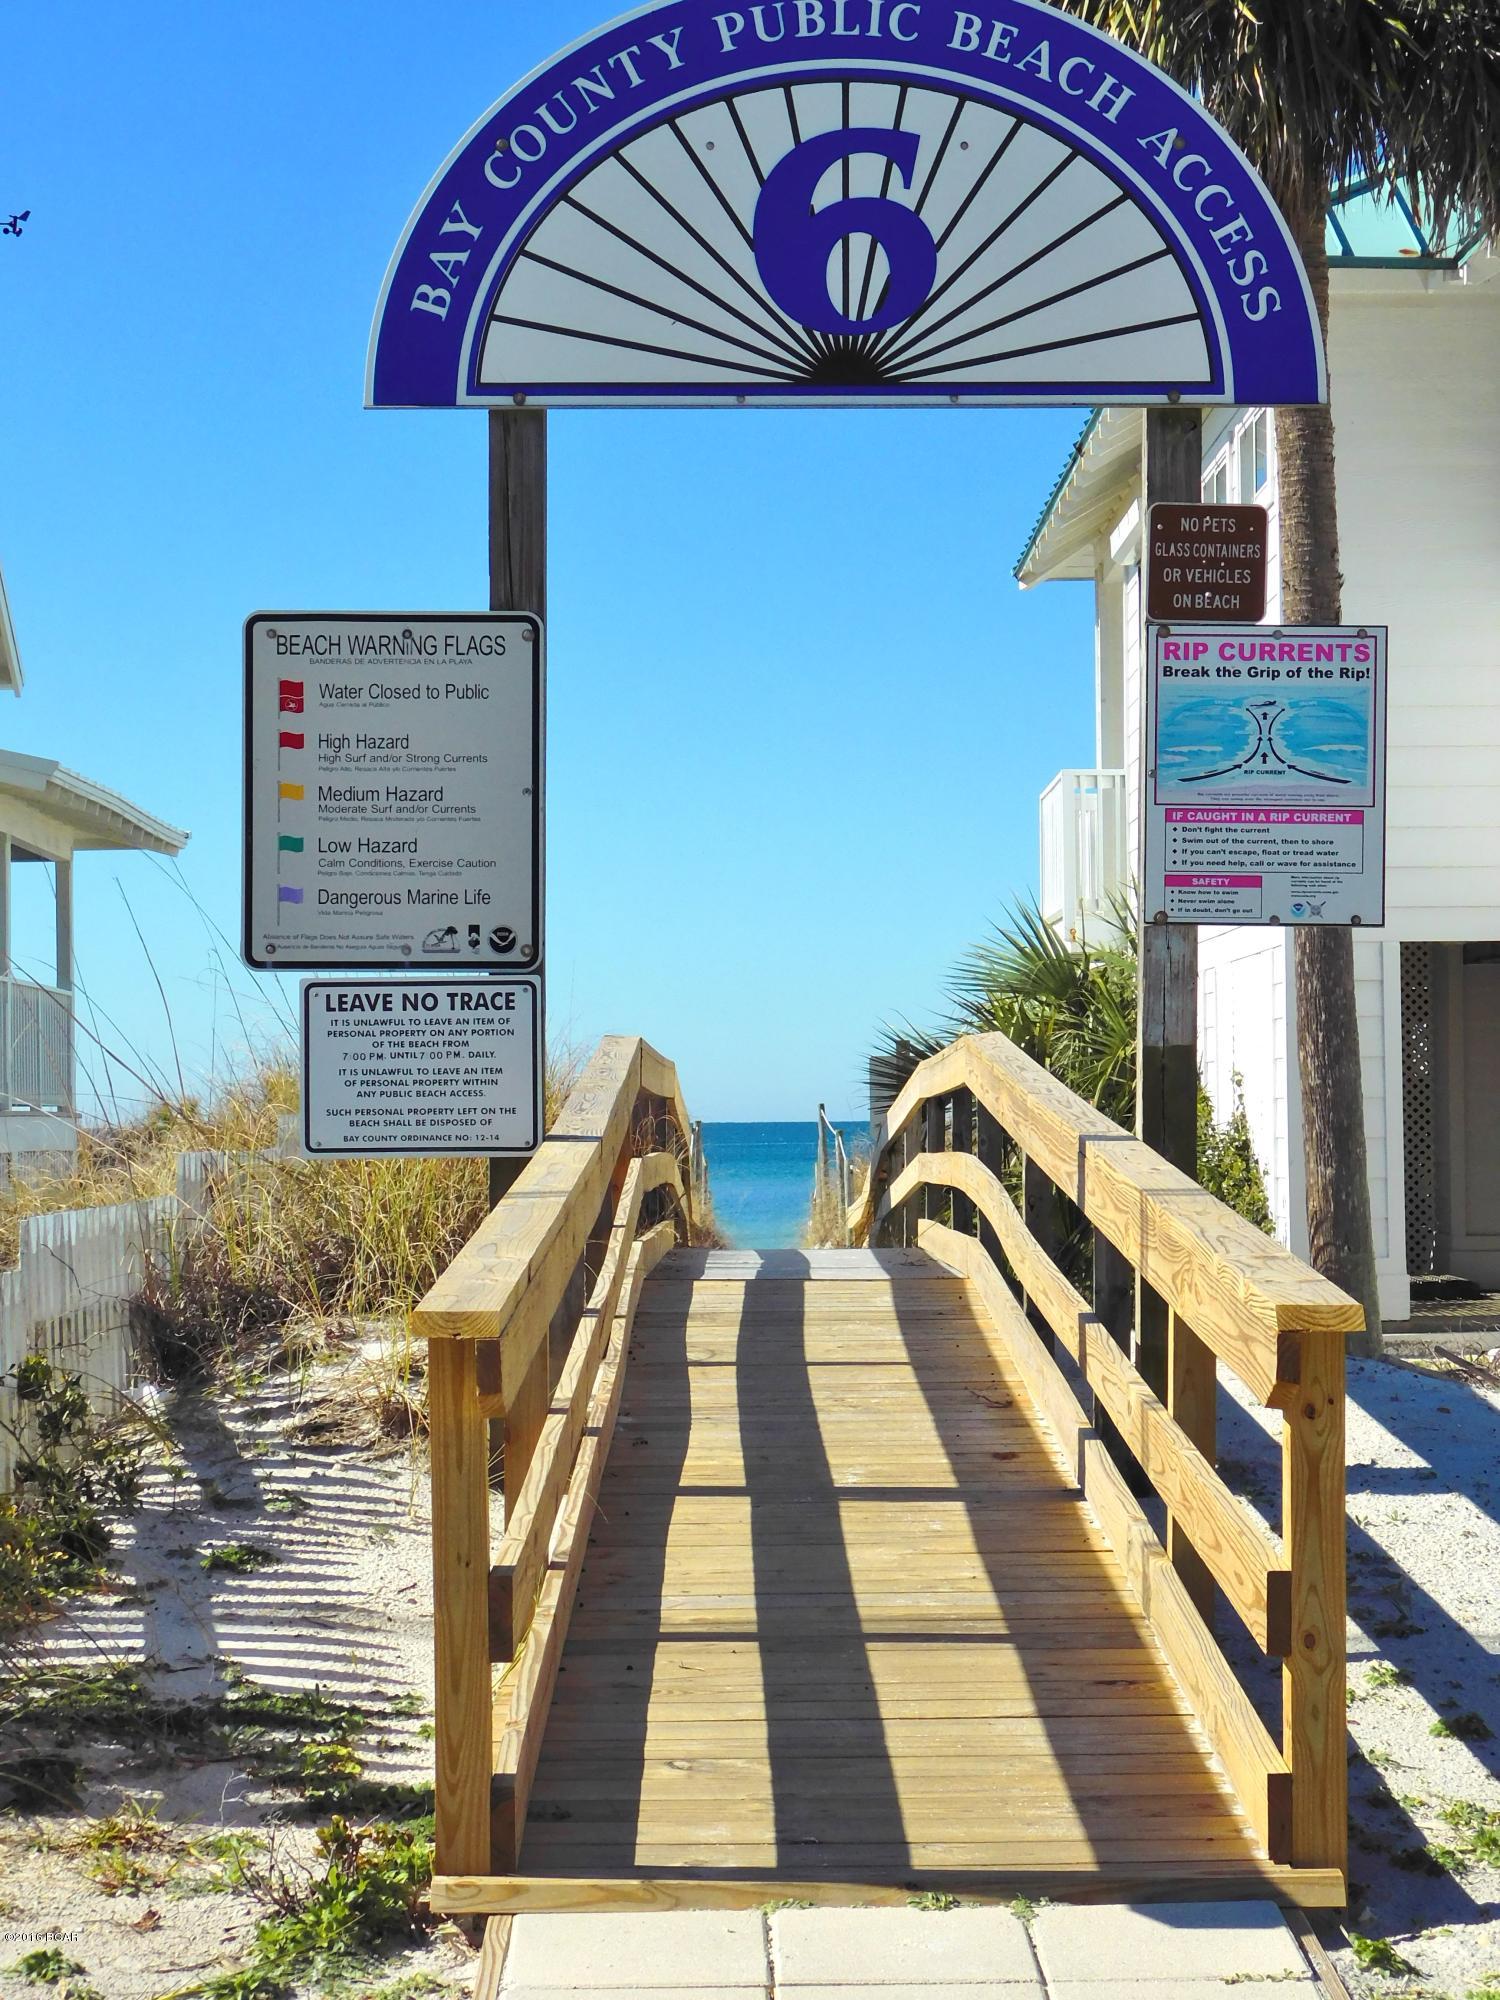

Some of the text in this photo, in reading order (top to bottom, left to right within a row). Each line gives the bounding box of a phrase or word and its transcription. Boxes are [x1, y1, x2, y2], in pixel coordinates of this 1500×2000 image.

[410, 0, 1282, 322] BAY COUNTY PUBLIC BEACH ACCESS
[752, 127, 940, 335] 6
[1181, 517, 1236, 533] NO PETS
[1155, 542, 1260, 559] GLASS CONTAINERS
[1163, 568, 1251, 584] OR VEHICLES
[1173, 593, 1240, 609] ON BEACH
[277, 635, 506, 656] BEACH WARNING FLAGS
[1163, 642, 1371, 663] RIP CURRENTS
[1163, 665, 1370, 682] Break the Grip of the Rip!
[319, 683, 489, 700] Water Closed to Public
[319, 733, 409, 755] High Hazard
[318, 754, 488, 765] High Surf and/or Strong Currents
[318, 786, 444, 802] Medium Hazard
[318, 804, 477, 814] Moderate Surf and/or Currents
[1172, 811, 1352, 823] IF CAUGHT IN A RIP CURRENT
[1204, 826, 1223, 834] fight
[318, 837, 418, 853] Low Hazard
[318, 858, 497, 868] Calm Conditions, Exercise Caution
[1192, 878, 1230, 888] SAFETY
[318, 889, 491, 909] Dangerous Marine Life
[326, 991, 515, 1012] LEAVE NO TRACE
[331, 1019, 338, 1027] IT
[342, 1019, 350, 1027] IS
[354, 1018, 405, 1027] UNLAWFUL
[409, 1018, 421, 1026] TO
[424, 1018, 452, 1026] LEAVE
[473, 1017, 495, 1026] ITEM
[498, 1017, 510, 1025] OF
[327, 1030, 377, 1038] PERSONAL
[379, 1029, 427, 1037] PROPERTY
[429, 1029, 445, 1037] ON
[471, 1028, 515, 1037] PORTION
[372, 1041, 384, 1049] OF
[409, 1040, 439, 1048] BEACH
[443, 1040, 469, 1048] FROM
[468, 1051, 497, 1059] DAILY.
[338, 1068, 347, 1076] IT
[350, 1068, 359, 1076] IS
[361, 1068, 414, 1076] UNLAWFUL
[416, 1068, 430, 1076] TO
[463, 1067, 478, 1075] AN
[481, 1067, 503, 1075] ITEM
[360, 1079, 408, 1087] PERSONAL
[413, 1079, 459, 1087] PROPERTY
[463, 1078, 498, 1086] WITHIN
[379, 1090, 413, 1098] PUBLIC
[415, 1090, 447, 1098] BEACH
[449, 1089, 486, 1097] ACCESS.
[326, 1107, 517, 1117] SUCH PERSONAL PROPERTY LEFT ON THE
[383, 1119, 413, 1127] SHALL
[415, 1119, 427, 1127] BE
[429, 1118, 477, 1127] DISPOSED
[480, 1118, 493, 1126] OF
[343, 1135, 360, 1143] BAY
[400, 1134, 453, 1142] ORDINANCE
[455, 1134, 472, 1142] NO:
